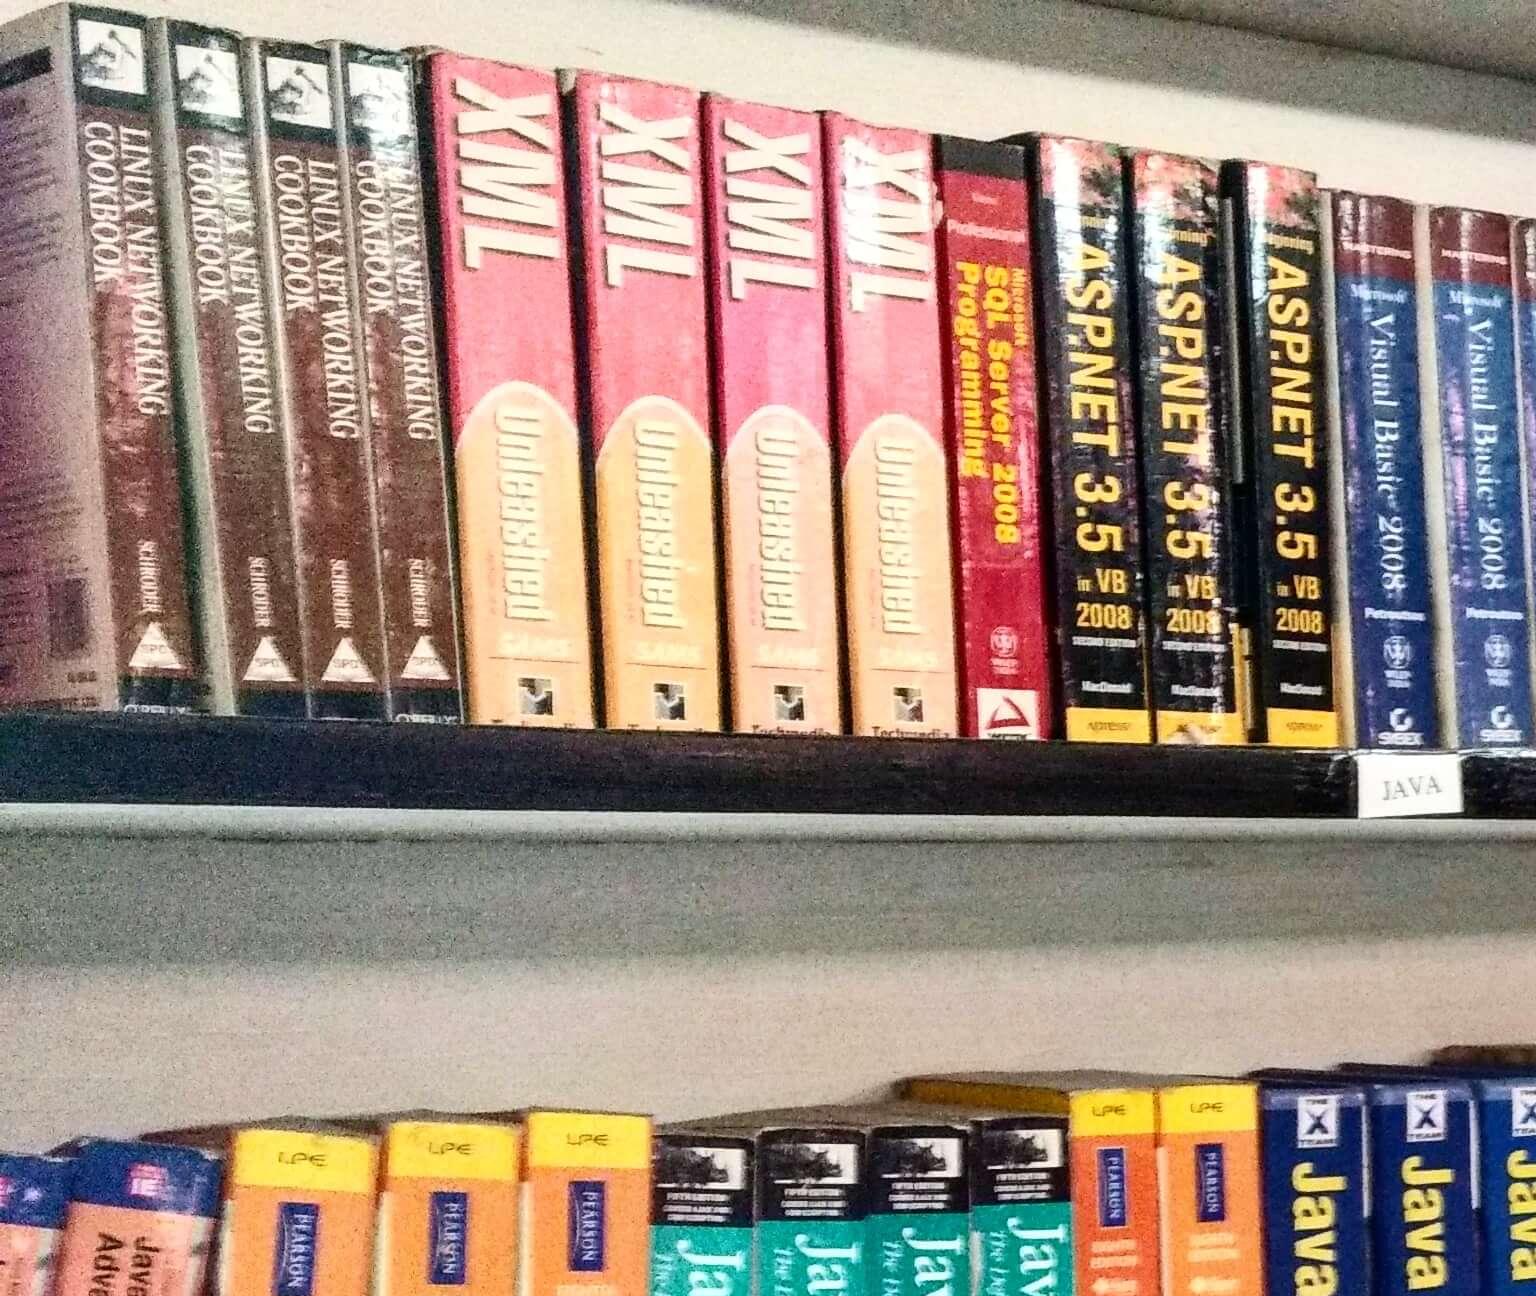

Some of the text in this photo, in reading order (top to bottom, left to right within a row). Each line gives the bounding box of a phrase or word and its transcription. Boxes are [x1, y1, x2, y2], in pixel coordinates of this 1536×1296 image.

[84, 121, 126, 285] COOKBOOK
[186, 144, 229, 306] COOKBOOK
[274, 154, 316, 312] COOKBOOK
[356, 159, 395, 315] COOKBOOK
[453, 77, 561, 271] XML
[599, 102, 697, 288] XML
[722, 117, 818, 302] XML
[126, 223, 171, 417] NETWORKING
[229, 243, 276, 434] NETWORKING
[307, 158, 360, 440] LINUX NETWORKING
[396, 254, 437, 441] NETWORKING
[953, 261, 990, 480] Programming
[982, 264, 1021, 545] SQL Server 2008
[1065, 242, 1125, 553] ASP.NET 3.5
[1156, 251, 1213, 560] ASP.NET 3.5
[1265, 254, 1319, 560] ASP.NET 3.5
[495, 405, 556, 621] Unleashed
[634, 418, 688, 629] Unleashed
[755, 429, 807, 632] Unleashed
[875, 437, 921, 635] Unleashed
[1095, 567, 1127, 595] VB
[1185, 574, 1217, 601] VB
[1293, 574, 1322, 600] VB
[1377, 515, 1408, 590] 2008
[1478, 516, 1510, 591] 2008
[1076, 602, 1133, 631] 2008
[1166, 607, 1222, 635] 2008
[1276, 607, 1324, 635] 2008
[1382, 775, 1443, 802] JAVA
[277, 1150, 329, 1167] LPE
[428, 1140, 473, 1156] LPE
[566, 1133, 609, 1147] LPE
[1092, 1104, 1127, 1117] LPE
[1190, 1102, 1225, 1114] LPE
[287, 1213, 316, 1289] PEARSON
[583, 1191, 602, 1262] PEARSON
[1400, 1155, 1456, 1291] Java
